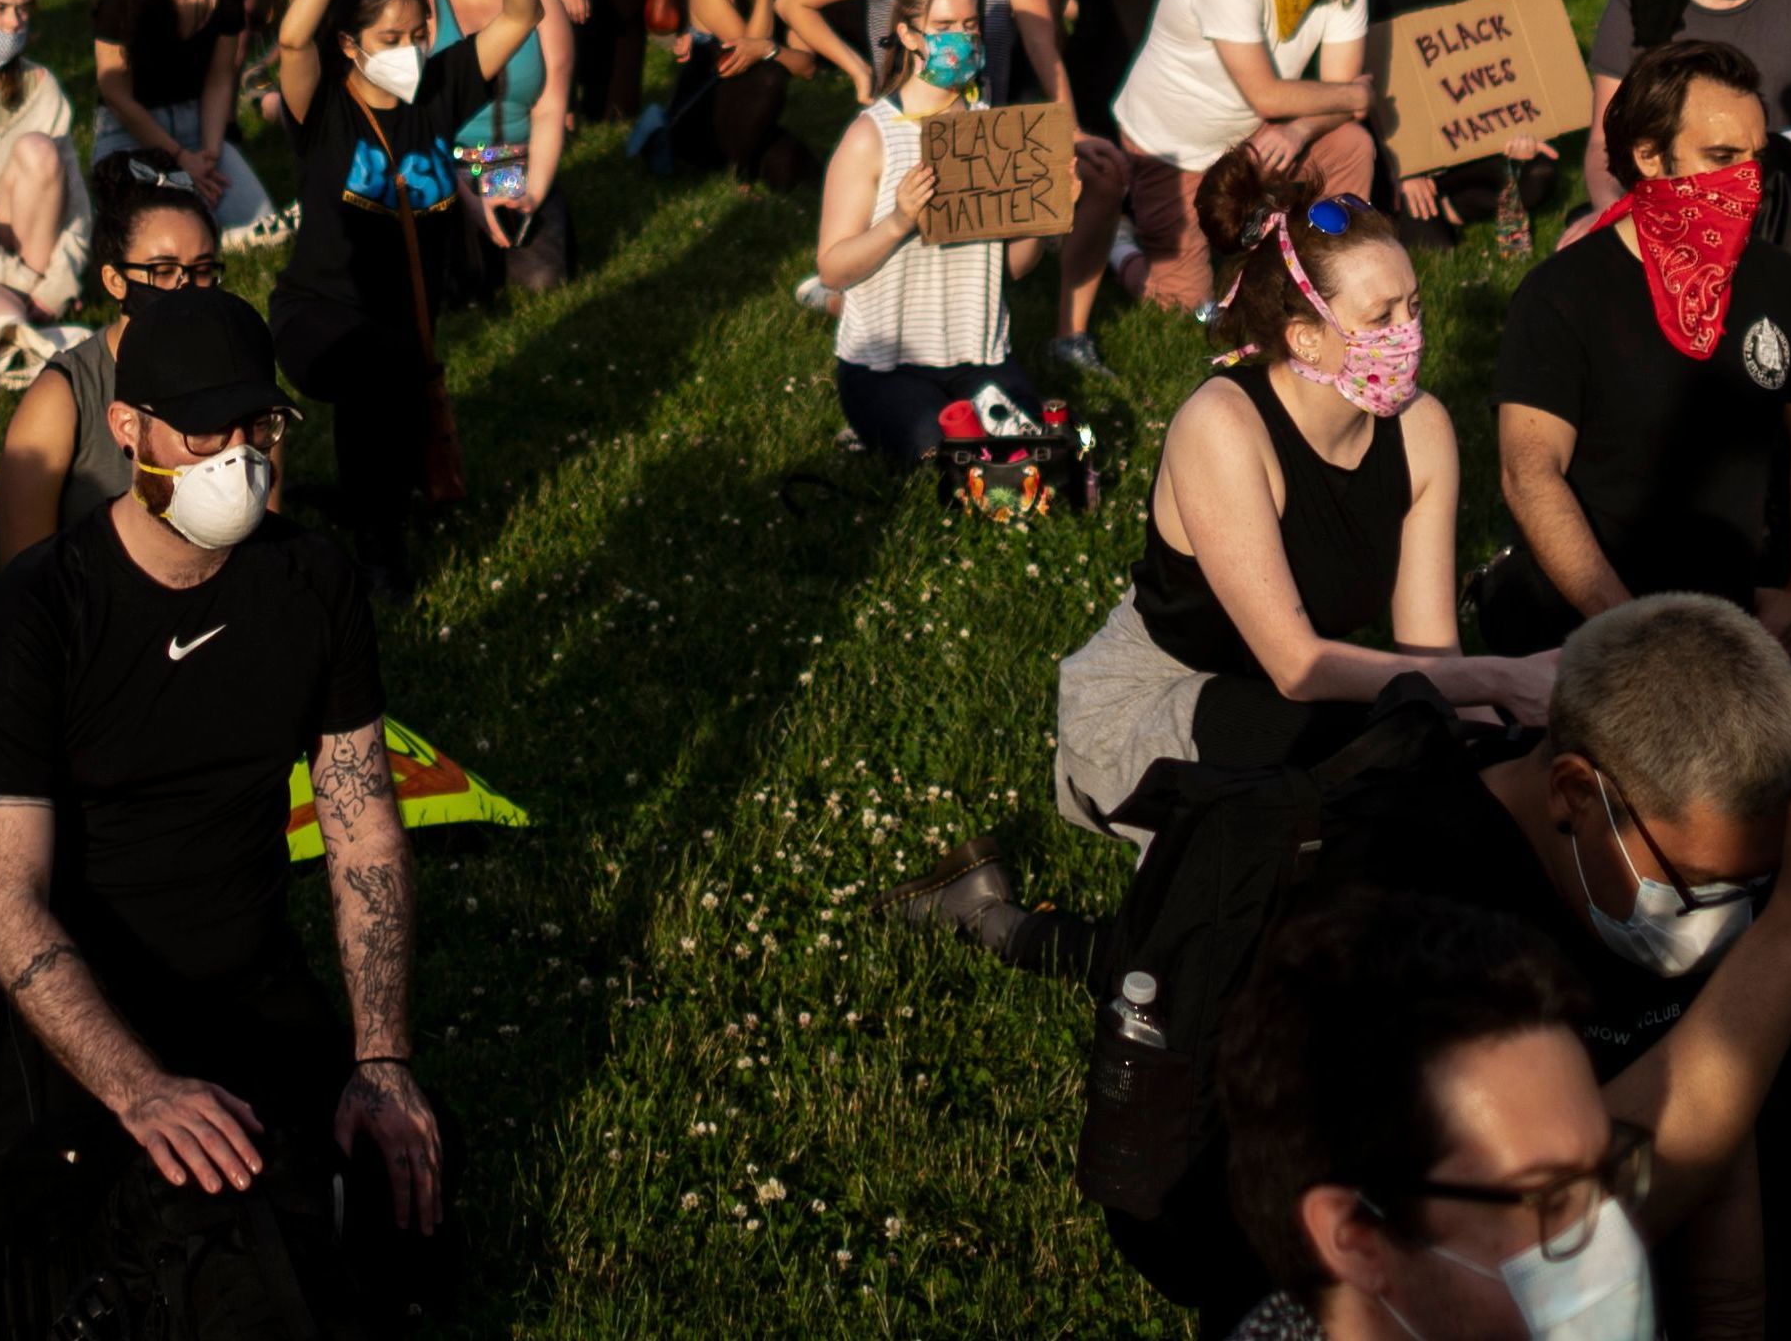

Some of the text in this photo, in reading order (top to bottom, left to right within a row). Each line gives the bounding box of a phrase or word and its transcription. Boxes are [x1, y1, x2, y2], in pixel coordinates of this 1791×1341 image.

[1415, 14, 1512, 68] BLACK
[1440, 57, 1516, 104] LIVES
[928, 110, 1052, 162] BLACK
[1441, 98, 1541, 151] MATTER
[926, 175, 1058, 236] MATTER
